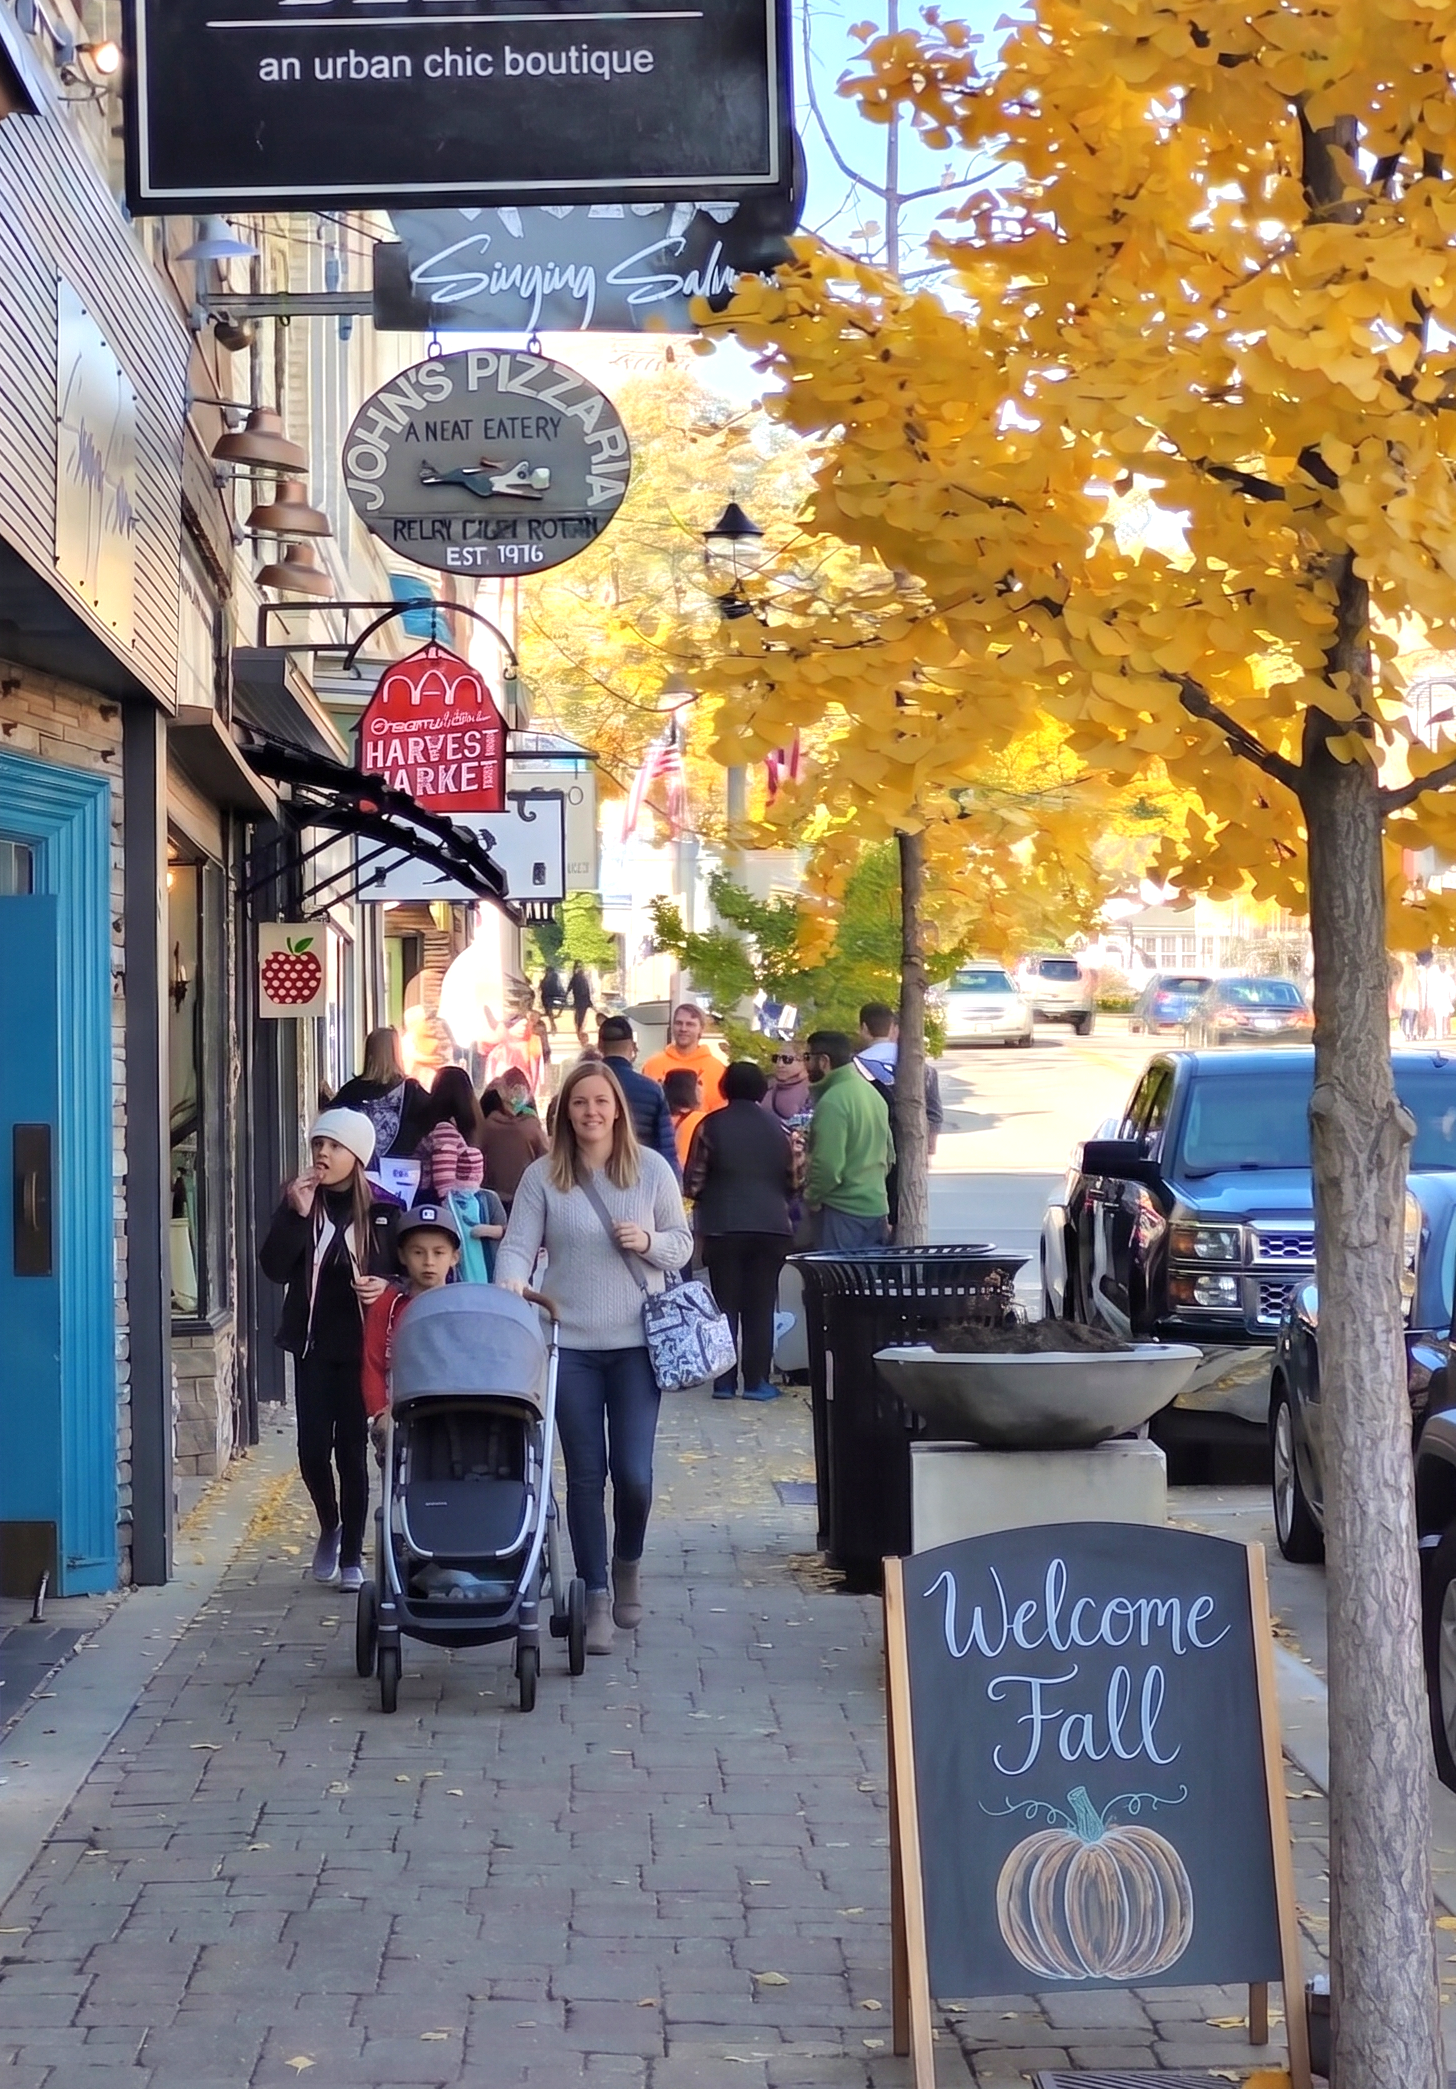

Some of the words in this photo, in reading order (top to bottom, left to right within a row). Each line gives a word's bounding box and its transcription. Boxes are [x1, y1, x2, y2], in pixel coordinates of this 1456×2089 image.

[258, 57, 301, 82] an
[313, 49, 412, 81] urban
[423, 46, 494, 78] chic
[504, 44, 655, 81] boutique
[410, 234, 596, 332] Singing
[346, 361, 453, 512] JOHN'S
[468, 351, 630, 508] PIZZARIA
[404, 421, 420, 443] A
[425, 419, 474, 442] NEAT
[483, 416, 562, 441] EATERY
[366, 729, 500, 770] HARVEST
[923, 1558, 1231, 1657] Welcome
[986, 1663, 1182, 1776] Fall
